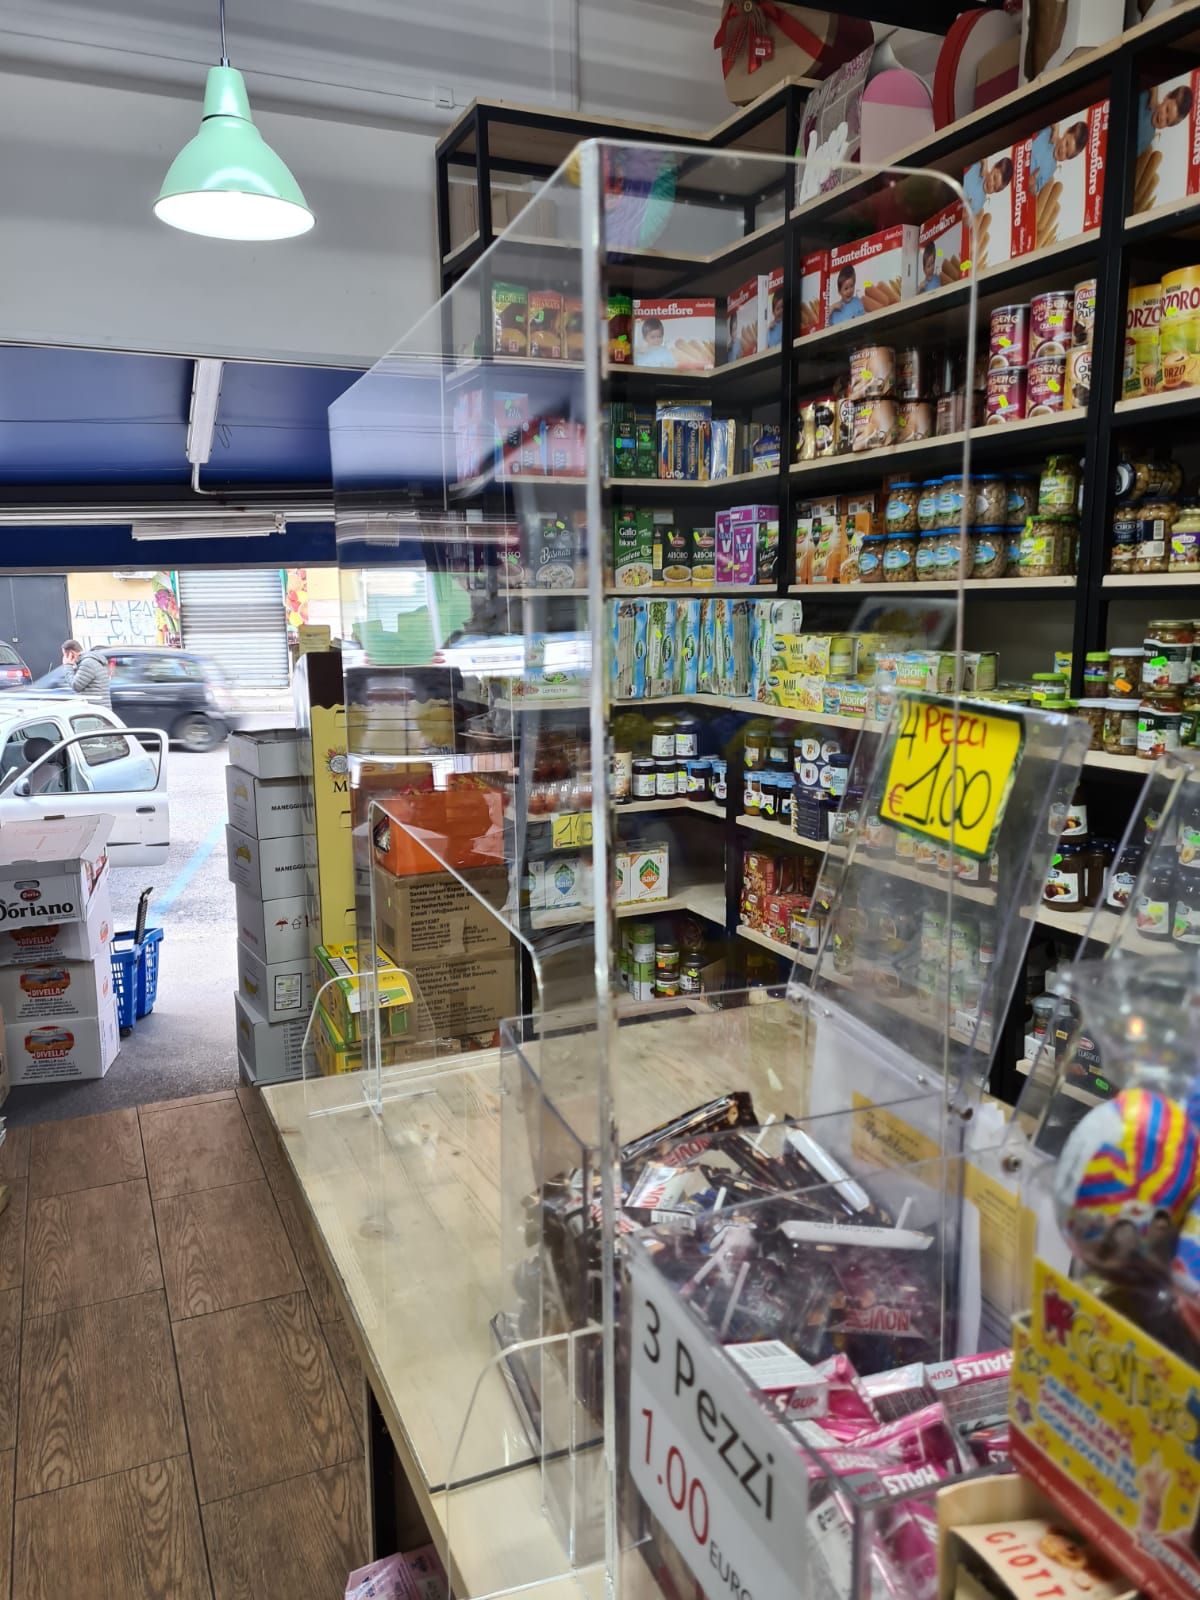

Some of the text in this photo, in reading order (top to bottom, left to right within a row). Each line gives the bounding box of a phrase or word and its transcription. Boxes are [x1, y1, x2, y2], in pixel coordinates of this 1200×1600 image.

[1088, 108, 1103, 195] montefiore
[1014, 145, 1027, 227] montefiore
[831, 241, 883, 267] montefiore
[633, 303, 693, 315] montefiore
[1164, 364, 1186, 378] ORZO
[619, 527, 637, 537] Gallo
[540, 546, 571, 564] Basmati
[76, 600, 120, 618] ALLA
[32, 989, 61, 997] DIVELLA
[36, 1050, 65, 1058] DIVELLA
[957, 1351, 1014, 1380] HALLS
[644, 1300, 776, 1521] 3 Pezzi
[642, 1408, 710, 1546] 1.00
[883, 1466, 941, 1496] HALLS
